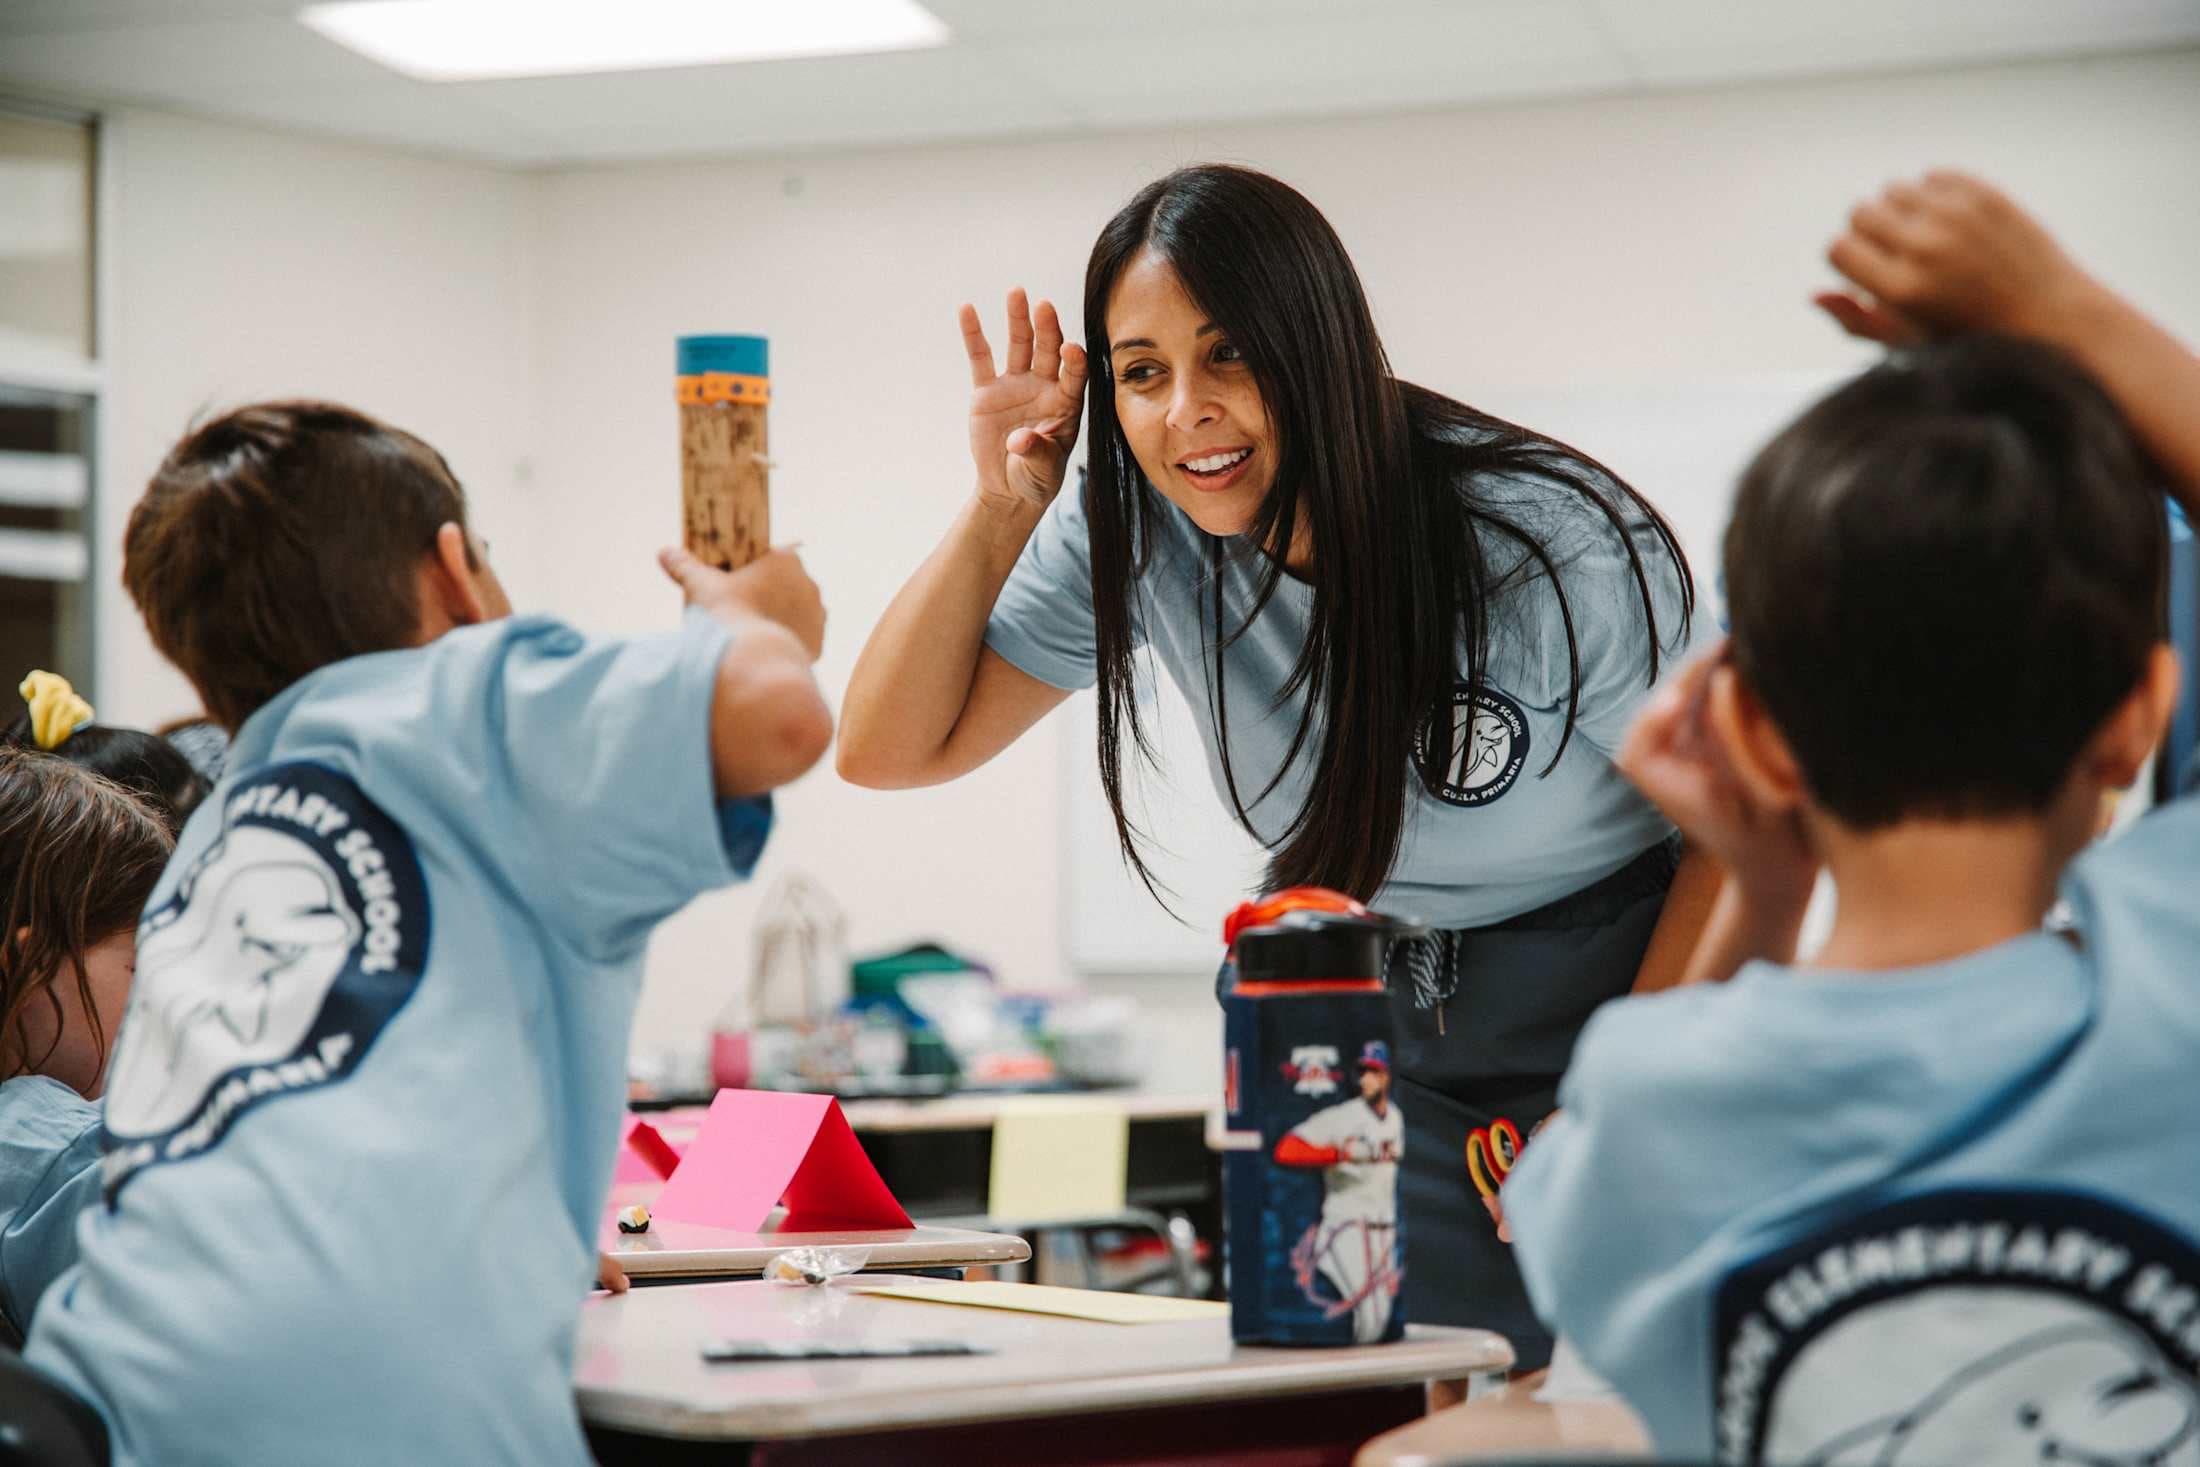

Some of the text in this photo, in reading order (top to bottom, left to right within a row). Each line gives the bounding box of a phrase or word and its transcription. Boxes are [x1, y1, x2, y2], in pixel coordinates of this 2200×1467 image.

[1498, 705, 1521, 738] SCHOOL
[1480, 757, 1521, 799] PRIMARIA
[334, 828, 401, 975] SCHOOL
